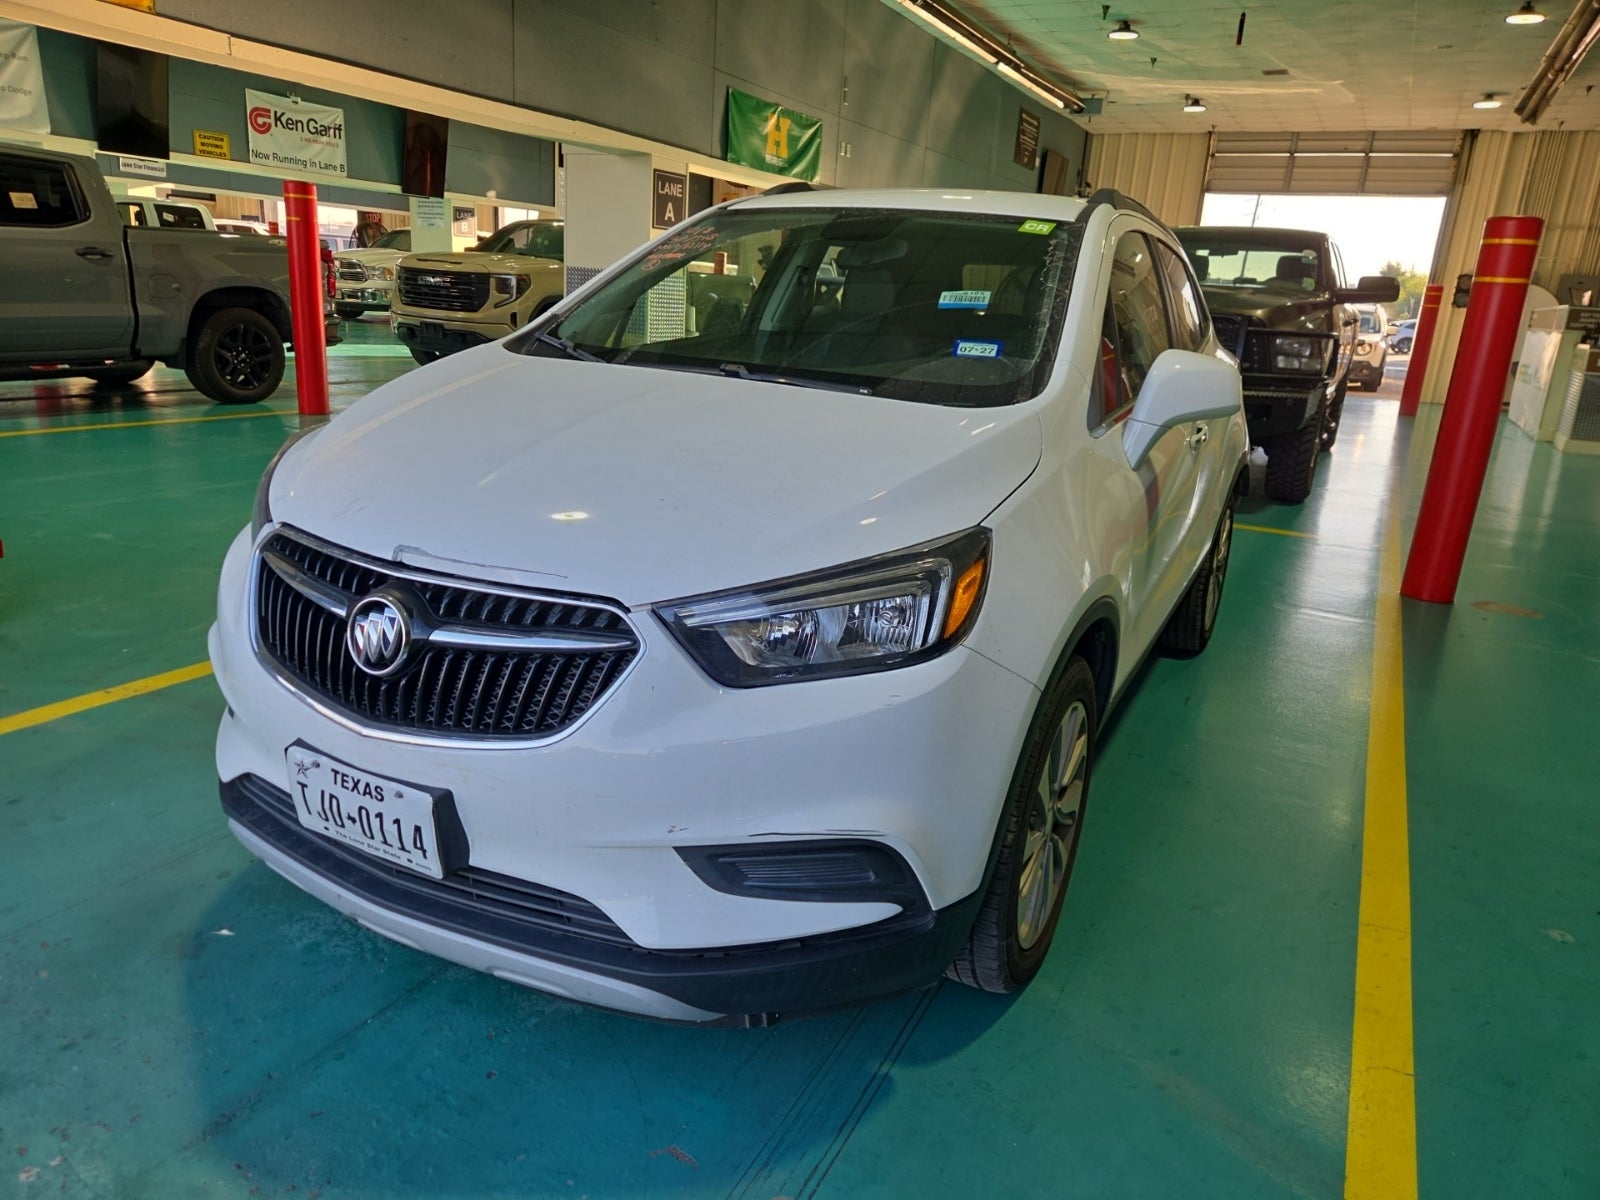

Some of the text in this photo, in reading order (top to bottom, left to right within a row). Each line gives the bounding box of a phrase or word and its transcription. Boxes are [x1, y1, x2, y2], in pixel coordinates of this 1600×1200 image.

[7, 85, 33, 97] Dodge
[273, 110, 343, 140] Ken Garff
[198, 133, 224, 143] CAUTION
[765, 113, 791, 159] H
[200, 142, 224, 150] MOVING
[198, 149, 228, 158] VEHICLES
[251, 149, 346, 173] Now Running in Lane B
[658, 180, 683, 198] LANE
[456, 211, 473, 220] LANE
[664, 201, 675, 222] A
[365, 213, 381, 223] STOP
[461, 221, 468, 232] B
[1024, 222, 1050, 231] CR
[331, 768, 385, 802] TEXAS
[335, 830, 348, 839] The
[366, 842, 381, 852] Star
[383, 849, 401, 860] State
